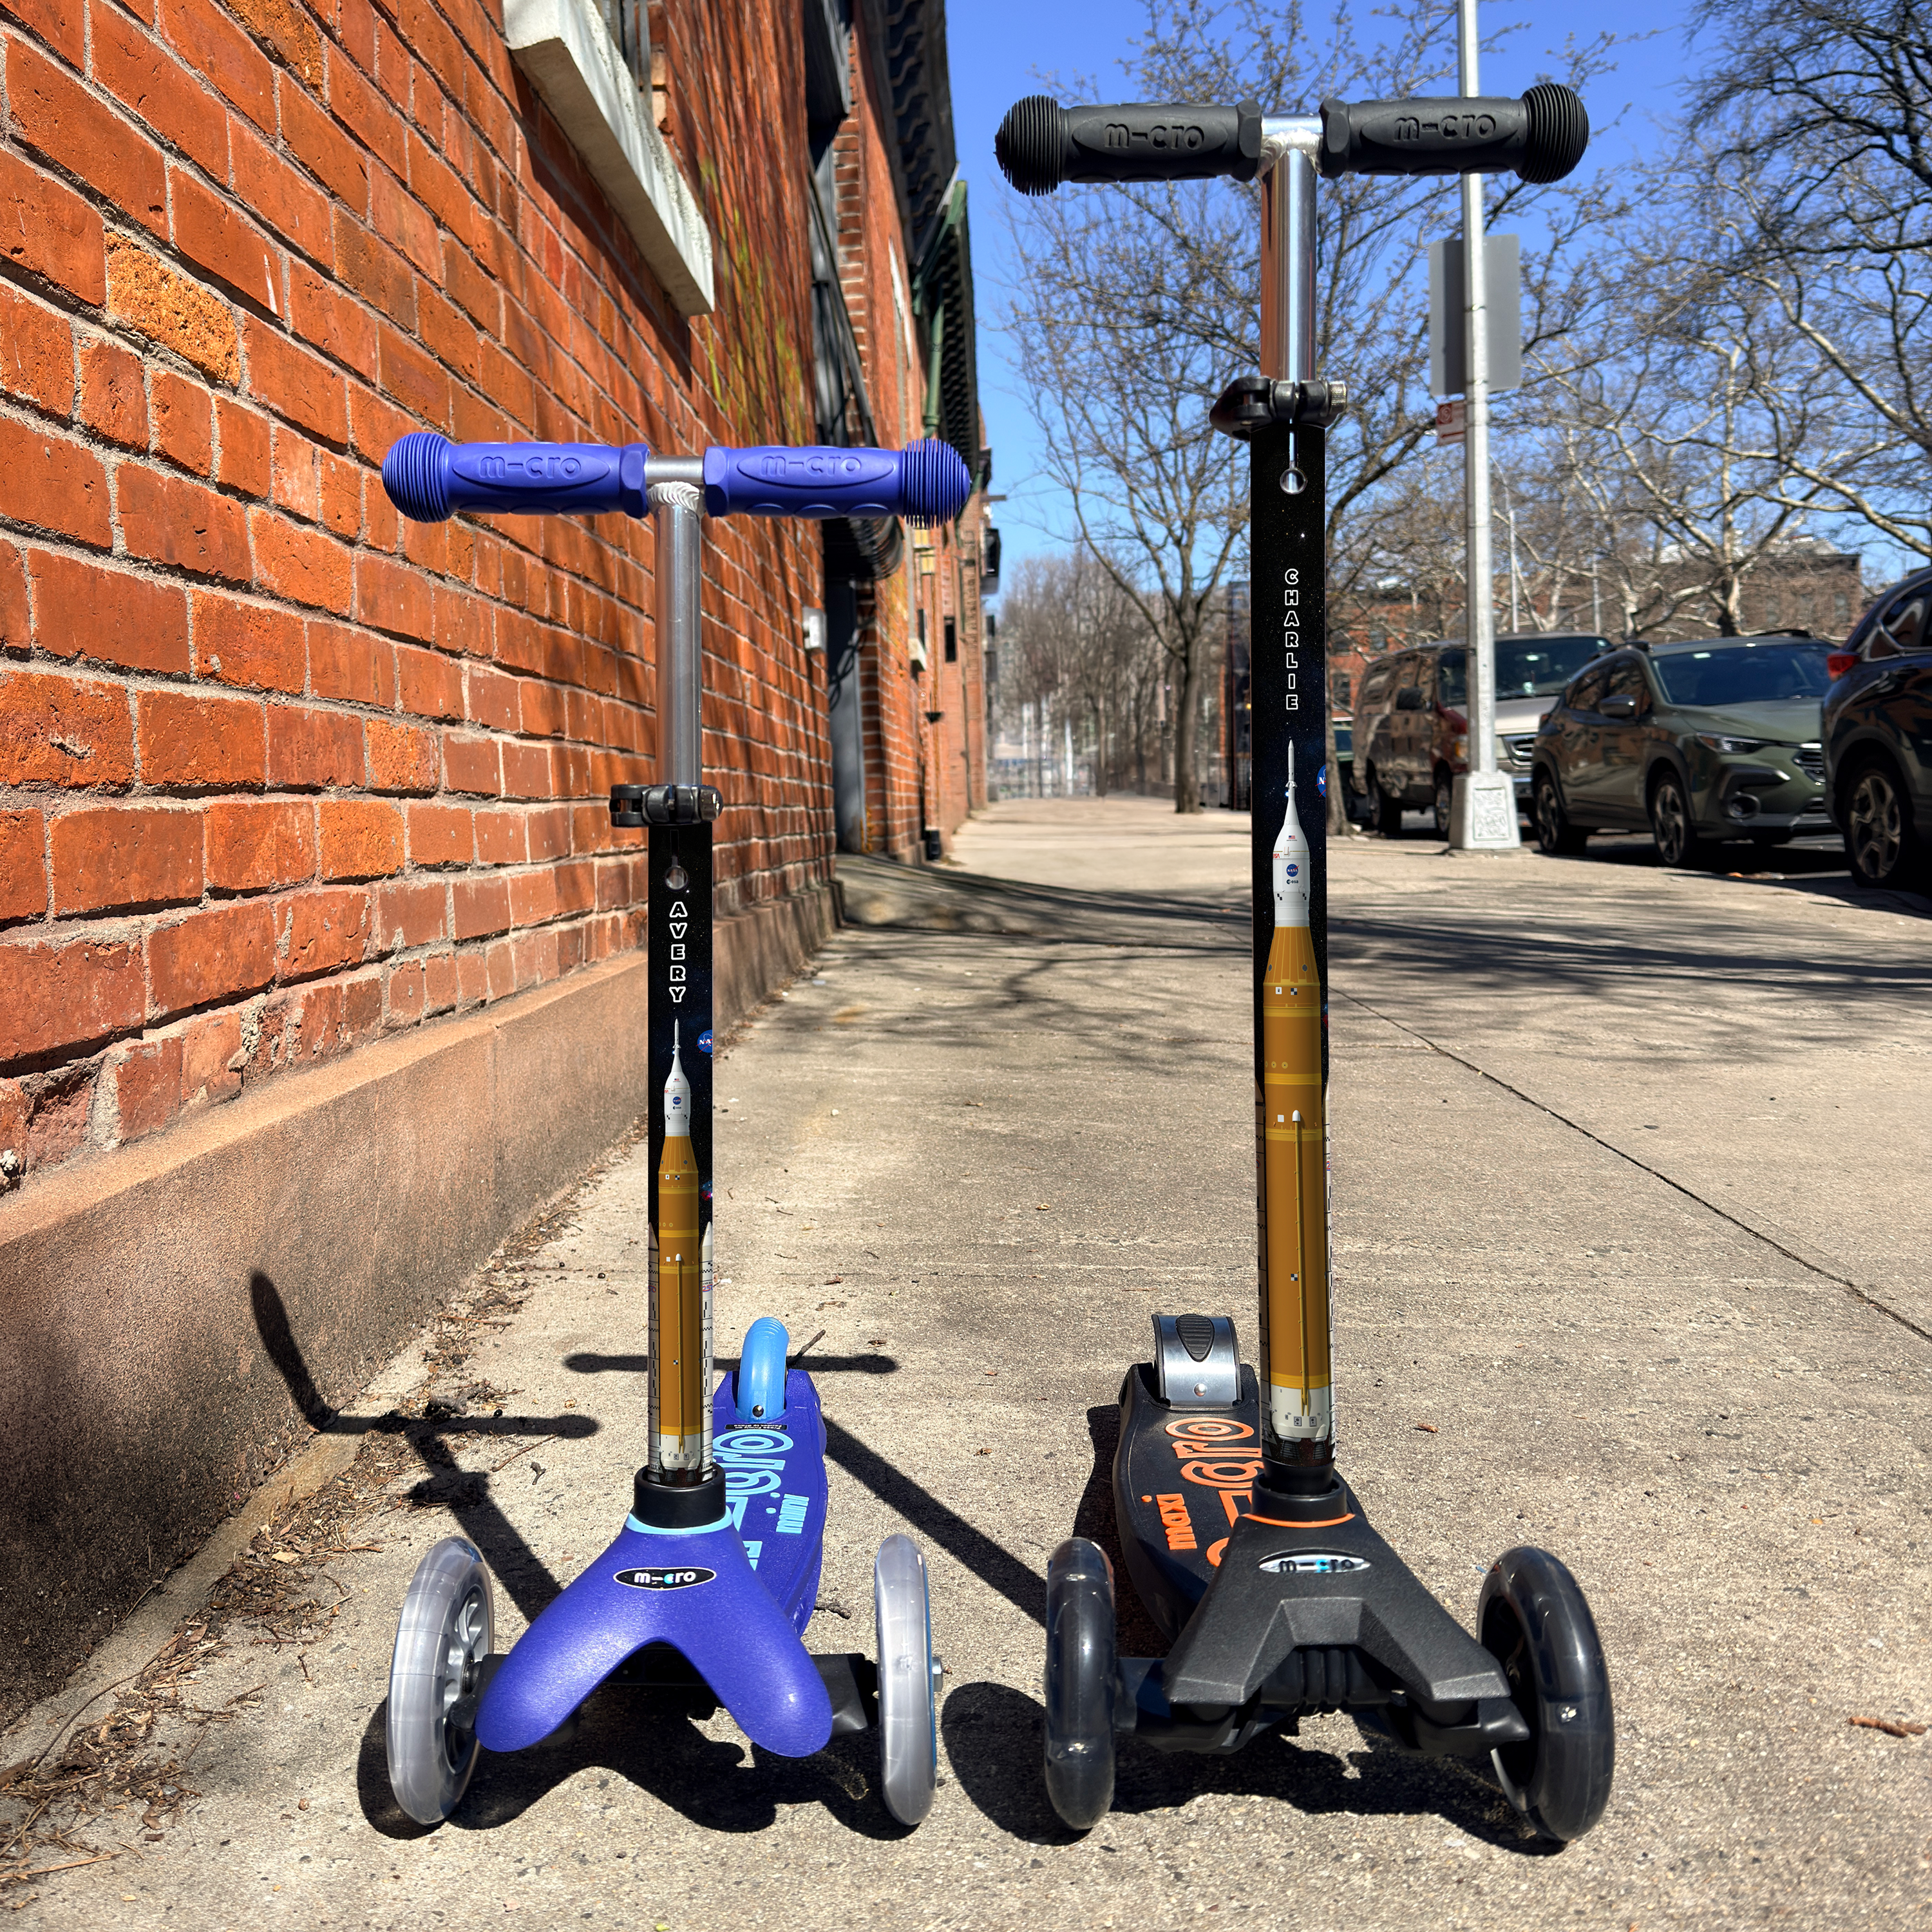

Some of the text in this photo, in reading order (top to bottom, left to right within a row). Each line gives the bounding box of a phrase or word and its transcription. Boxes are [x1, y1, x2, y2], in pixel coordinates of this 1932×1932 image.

[1284, 569, 1300, 710] CHARLIE
[669, 902, 688, 1003] AVERY
[1141, 1493, 1197, 1550] maxi
